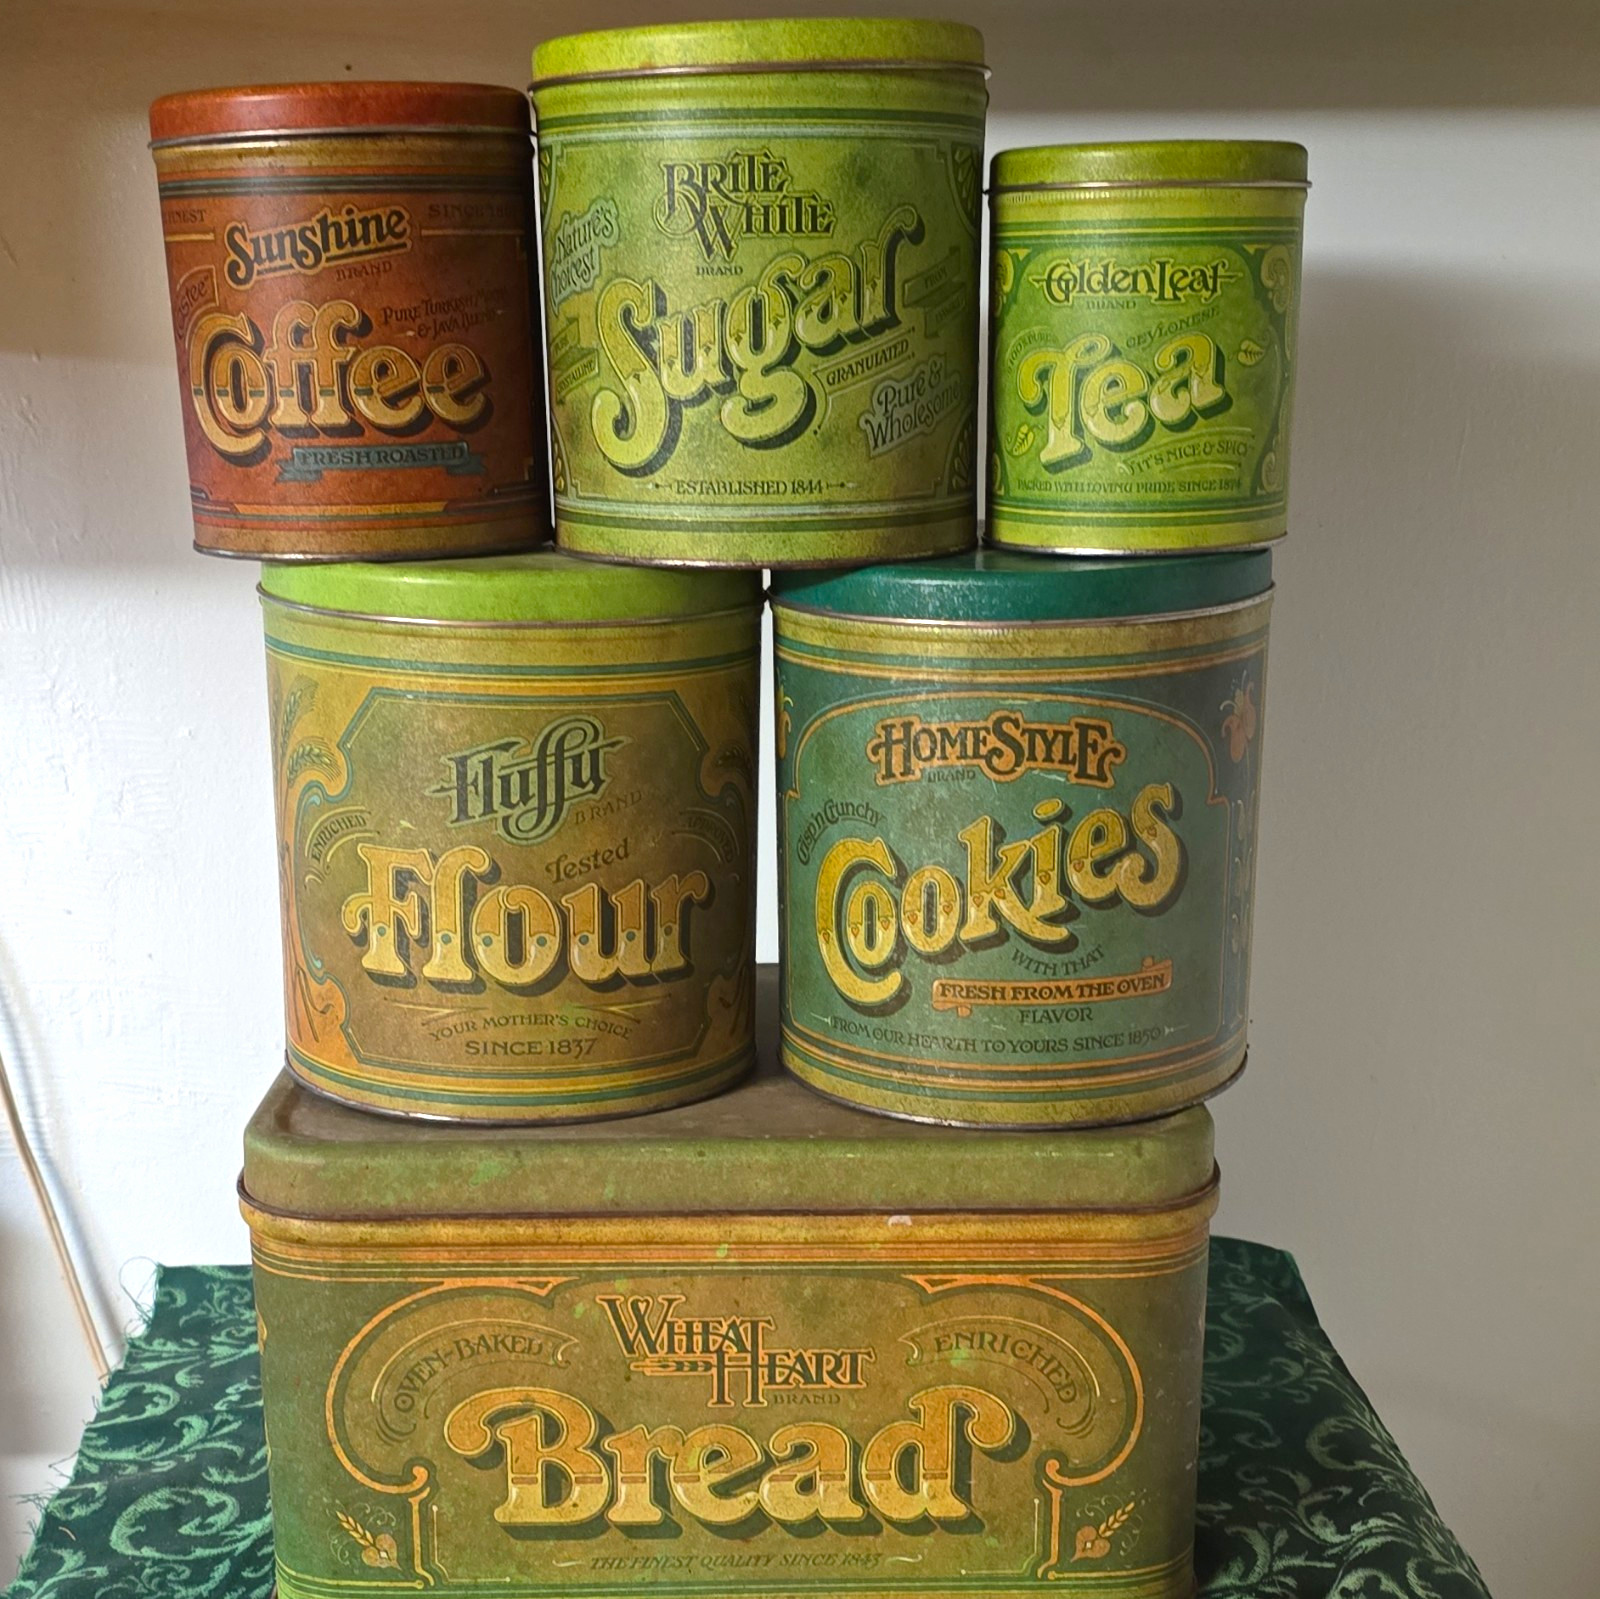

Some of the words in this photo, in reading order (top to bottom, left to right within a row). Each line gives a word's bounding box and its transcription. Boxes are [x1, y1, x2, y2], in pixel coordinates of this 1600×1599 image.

[656, 152, 789, 228] BRITE
[225, 207, 409, 286] Sunshine
[696, 194, 835, 262] WHITE
[336, 261, 393, 281] BRAND
[695, 265, 743, 276] BRAND
[380, 305, 420, 327] PURE
[1087, 299, 1137, 311] BRAND
[592, 206, 924, 476] Sugar
[826, 339, 910, 386] GRANULATED
[190, 300, 490, 461] Coffee
[877, 372, 926, 415] Pure
[928, 360, 943, 388] &
[1017, 331, 1232, 474] Tea
[867, 381, 961, 452] Wholesome
[299, 448, 372, 470] FRESH
[375, 445, 467, 467] ROASTED
[1166, 443, 1201, 463] NICE
[675, 478, 788, 497] ESTABLISHED
[1136, 481, 1175, 494] PRIDE
[1178, 479, 1217, 492] SINCE
[432, 719, 626, 838] Fluffy
[928, 768, 976, 784] BRAND
[574, 790, 642, 825] BRAND
[311, 814, 367, 863] ENRICHED
[546, 840, 630, 884] Tested
[341, 843, 713, 993] Flour
[816, 782, 1187, 1015] Cookies
[1012, 948, 1058, 976] WITH
[1062, 945, 1106, 976] THAT
[939, 983, 1008, 1001] FRESH
[1010, 983, 1073, 1001] FROM
[1075, 979, 1114, 998] THE
[1115, 973, 1166, 995] OVEN
[430, 1019, 478, 1042] YOUR
[482, 1013, 570, 1029] MOTHER'S
[574, 1014, 634, 1039] CHOICE
[832, 1015, 870, 1038] FROM
[872, 1027, 904, 1045] OUR
[907, 1032, 978, 1053] HEARTH
[981, 1037, 1006, 1053] TO
[1007, 1037, 1069, 1054] YOURS
[1073, 1032, 1125, 1052] SINCE
[1128, 1026, 1162, 1048] 1850
[1018, 1007, 1094, 1025] FLAVOR
[464, 1040, 543, 1056] SINCE
[548, 1038, 598, 1059] 1837
[598, 1295, 776, 1357] WHEAT
[393, 1332, 543, 1414] OVEN-BAKED
[708, 1346, 875, 1407] HEART
[935, 1329, 1078, 1403] ENRICHED
[773, 1393, 840, 1404] BRAND
[444, 1386, 1026, 1537] Bread
[590, 1556, 629, 1570] THE
[630, 1556, 698, 1570] FINEST
[700, 1554, 777, 1570] QUALITY
[778, 1553, 839, 1569] SINCE
